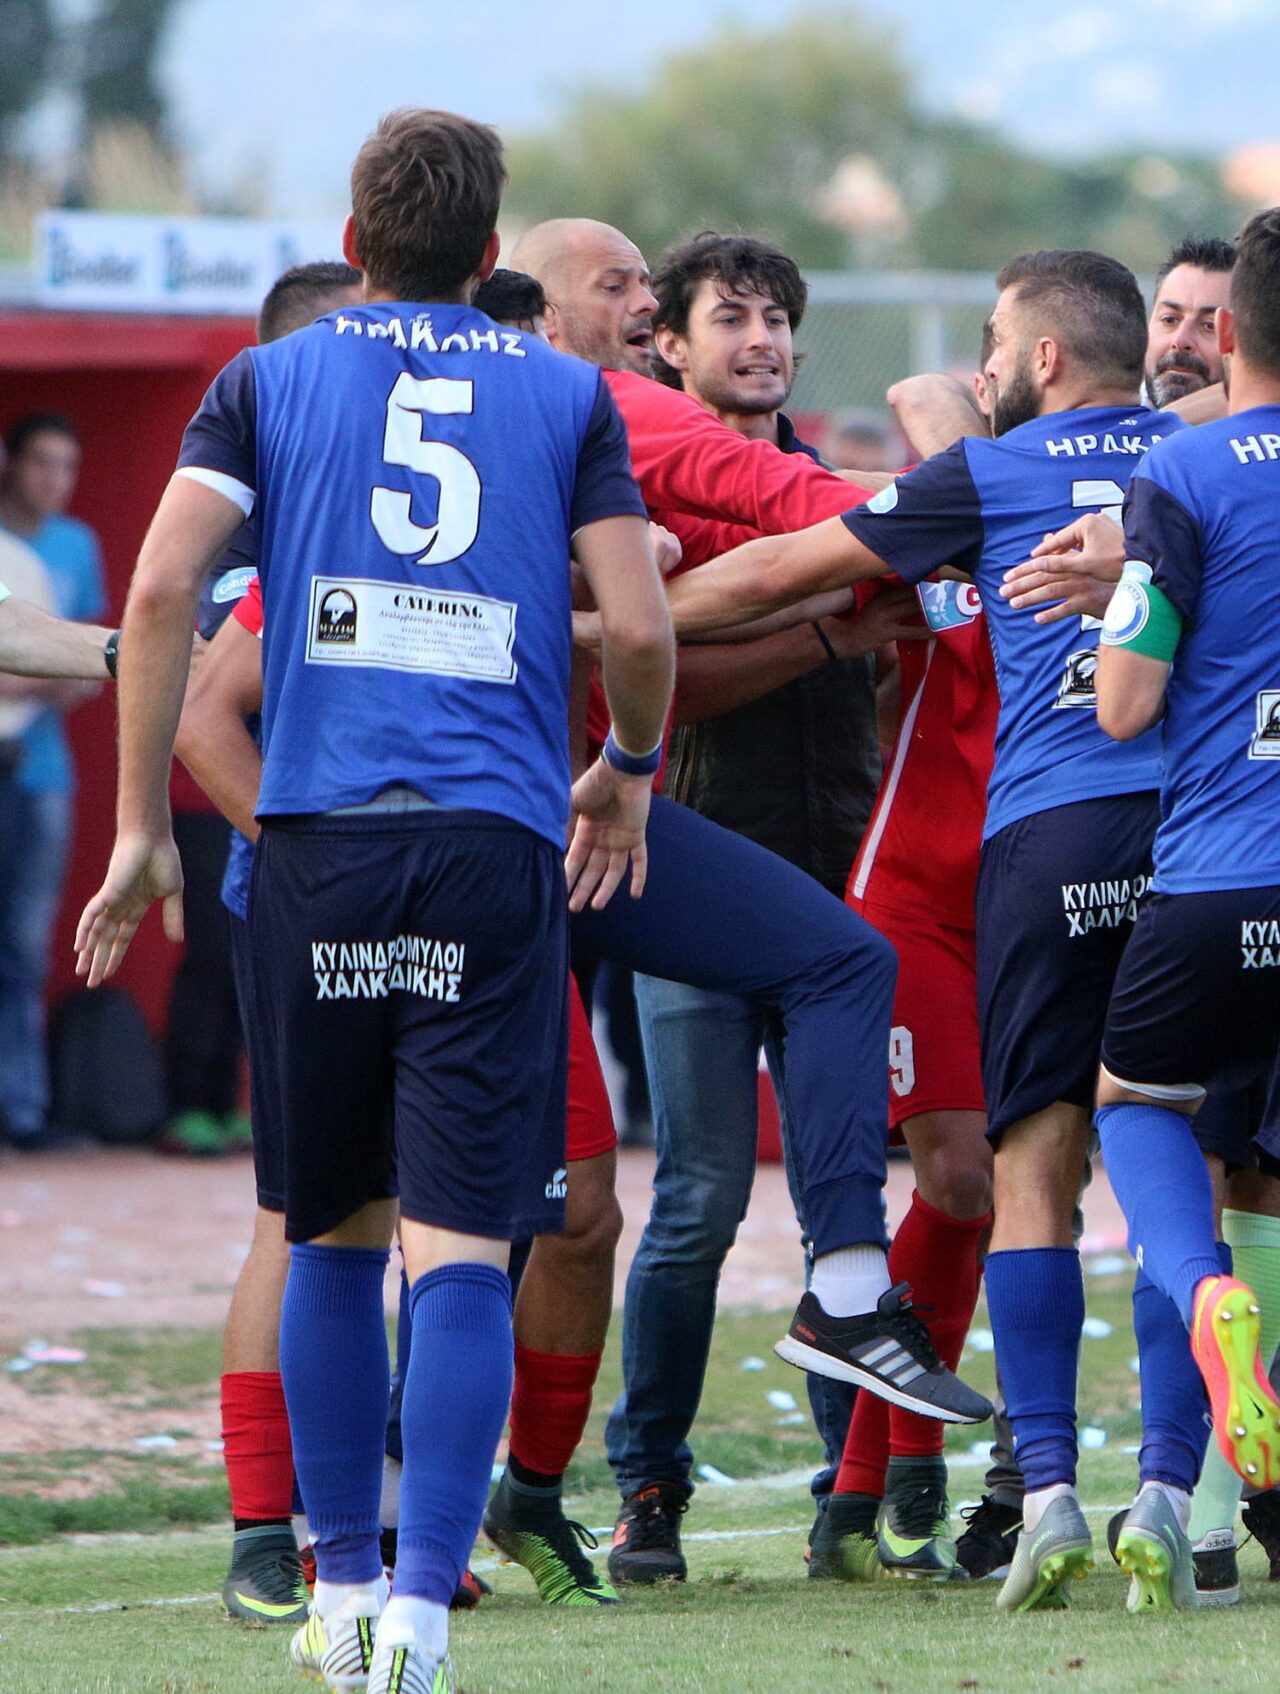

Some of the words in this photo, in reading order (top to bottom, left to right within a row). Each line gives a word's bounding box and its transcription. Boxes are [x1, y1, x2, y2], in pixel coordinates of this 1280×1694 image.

[371, 371, 482, 566] 5
[394, 594, 483, 619] CATERING
[312, 934, 465, 972] ΚΥΛΙΝΔΡΟΜΥΛΟΙ
[889, 1026, 915, 1097] 9
